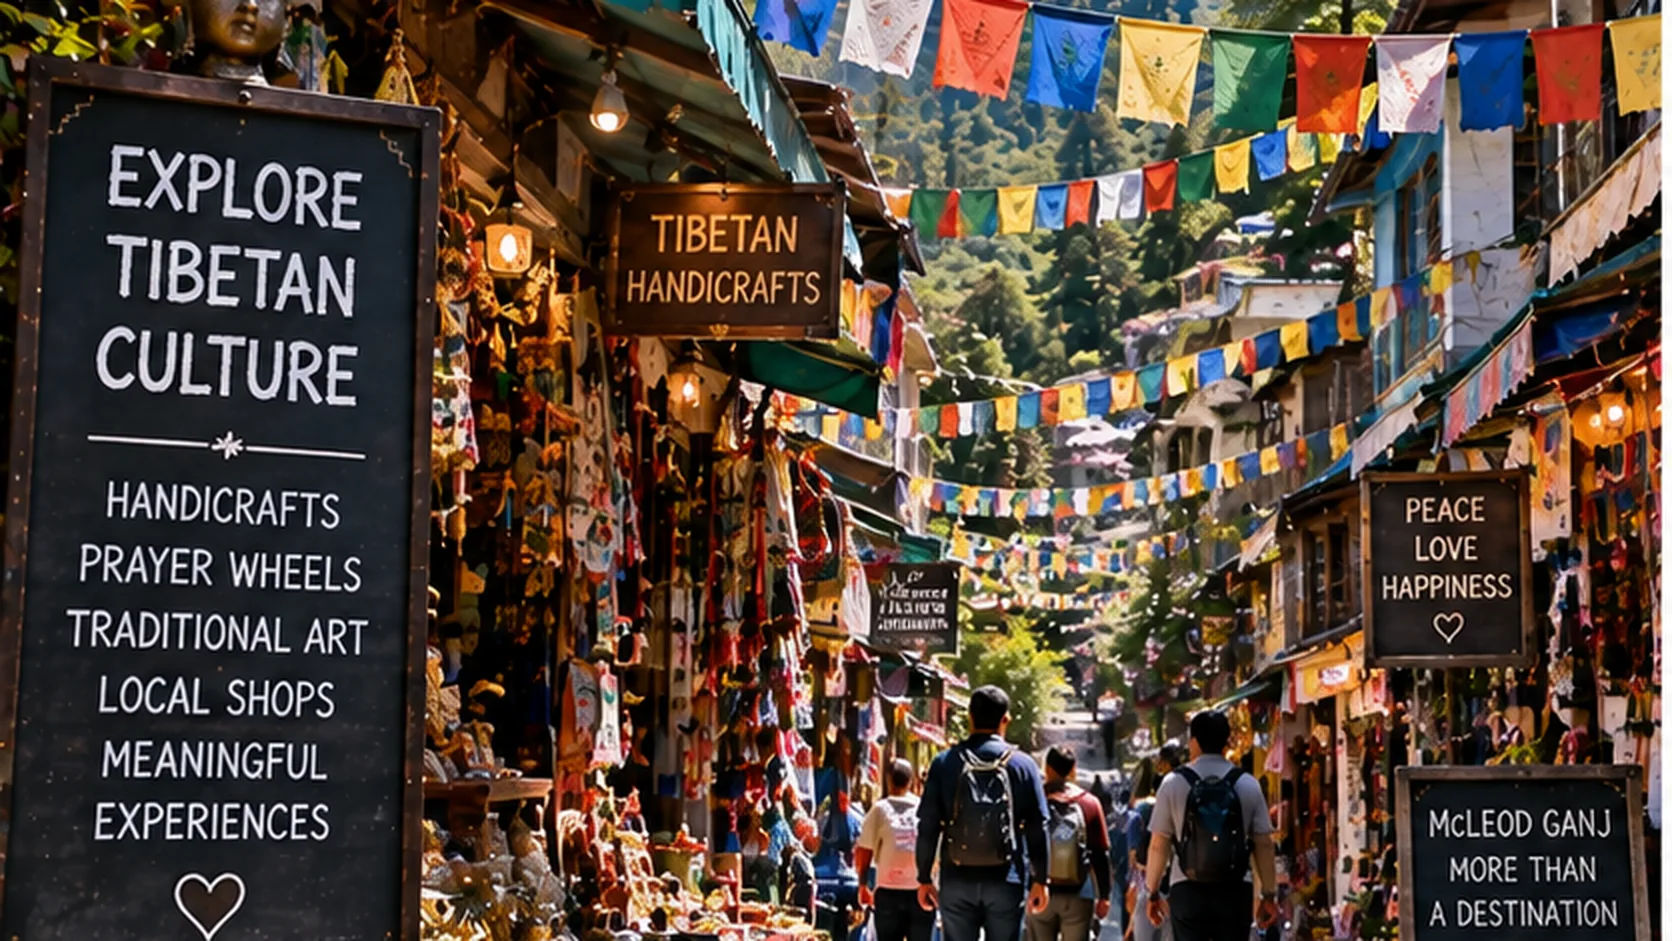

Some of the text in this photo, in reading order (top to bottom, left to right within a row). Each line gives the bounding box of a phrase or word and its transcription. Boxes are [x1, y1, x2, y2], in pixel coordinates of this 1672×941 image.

[107, 144, 363, 231] EXPLORE
[650, 213, 798, 254] TIBETAN
[106, 234, 356, 318] TIBETAN
[627, 270, 821, 305] HANDICRAFTS
[96, 325, 359, 407] CULTURE
[107, 480, 340, 530] HANDICRAFTS
[1406, 496, 1485, 524] PEACE
[79, 543, 361, 593] PRAYER WHEELS
[1415, 535, 1478, 562] LOVE
[1382, 573, 1513, 600] HAPPINESS
[66, 609, 369, 655] TRADITIONAL ART
[99, 675, 335, 718] LOCAL SHOPS
[102, 740, 328, 780] MEANINGFUL
[94, 802, 330, 841] EXPERIENCES
[1429, 809, 1611, 838] McLEOD GANJ
[1450, 856, 1596, 883] MORE THAN
[1429, 899, 1618, 927] A DESTINATION
